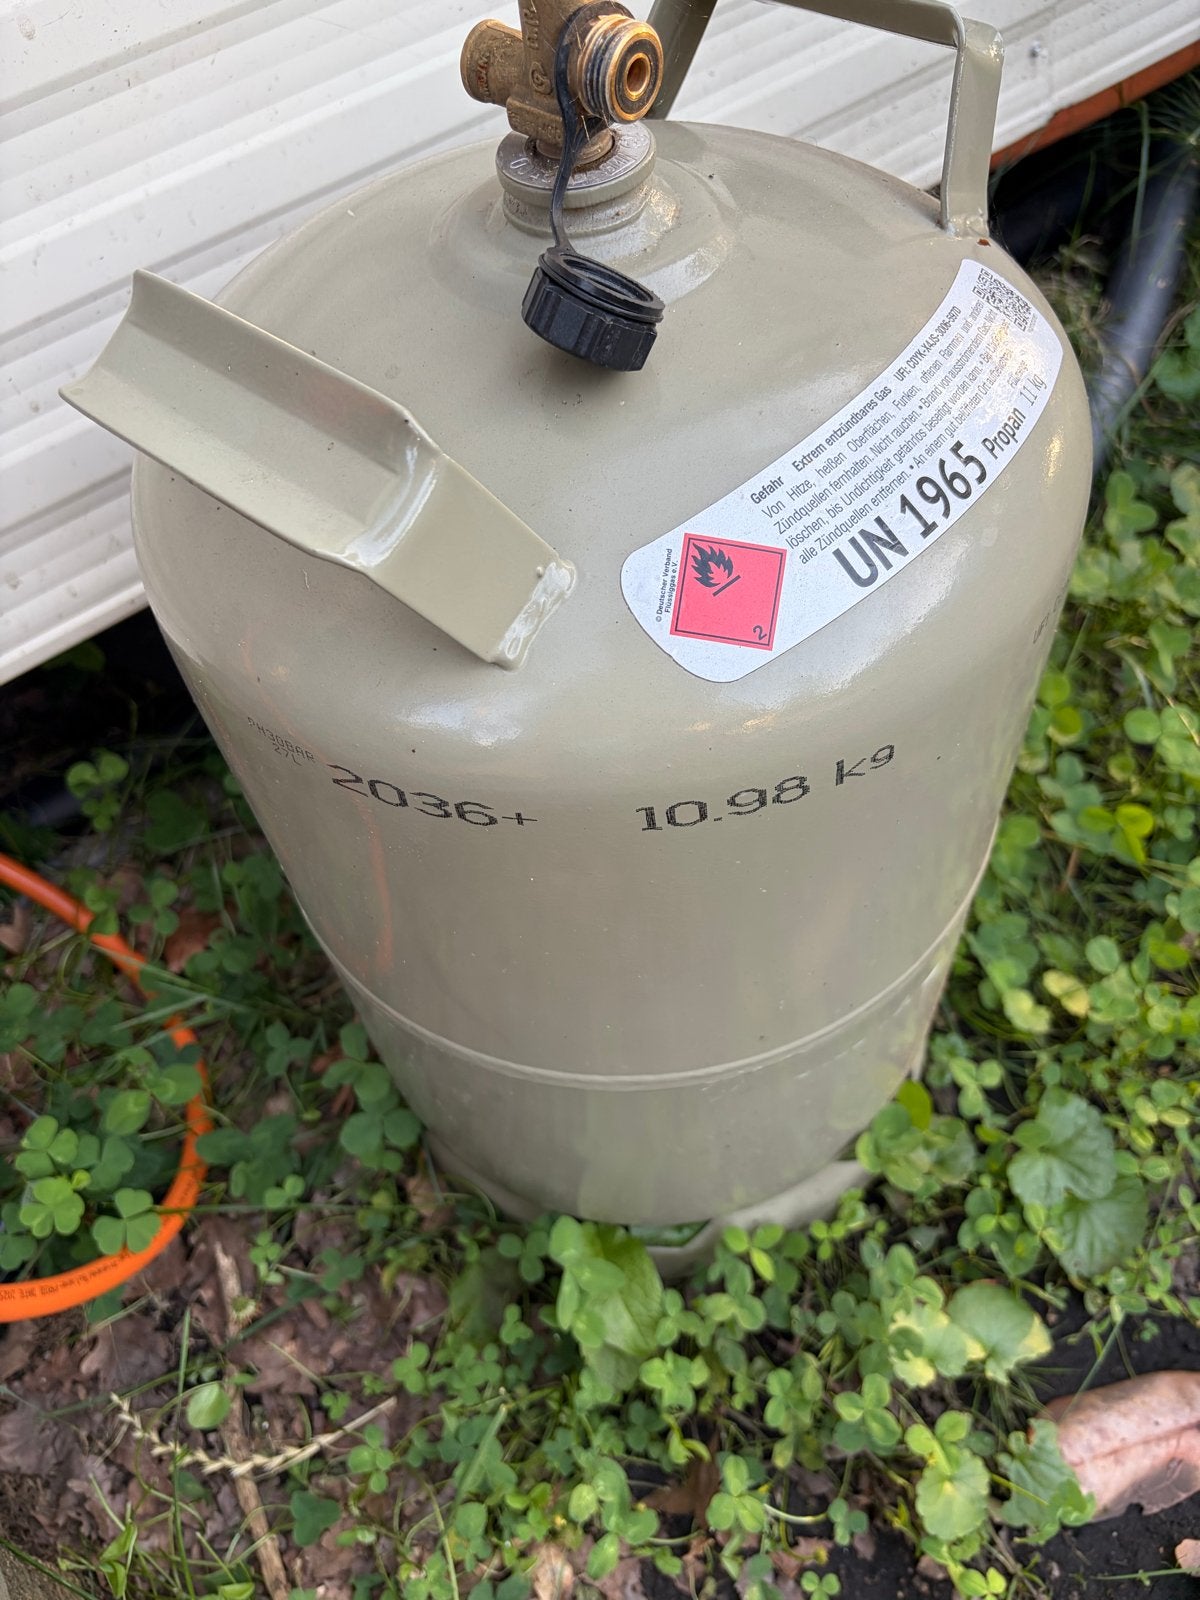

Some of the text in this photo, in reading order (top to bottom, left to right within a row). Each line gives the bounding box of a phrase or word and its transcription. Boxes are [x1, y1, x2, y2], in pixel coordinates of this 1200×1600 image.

[750, 476, 784, 504] Gefahr
[792, 443, 827, 472] Extrem
[825, 399, 878, 446] entzündbares
[874, 386, 892, 401] Gas
[893, 366, 911, 381] UFI:
[761, 500, 786, 519] Von
[786, 479, 816, 501] Hitze,
[815, 452, 847, 478] heißen
[846, 412, 896, 452] Oberflächen,
[892, 385, 922, 410] Funken,
[920, 360, 943, 383] offenen
[773, 487, 833, 535] Zündquellen
[828, 454, 874, 492] fernhalten.
[869, 435, 894, 457] Nicht
[891, 410, 922, 439] rauchen.
[920, 385, 942, 408] Brand
[938, 375, 953, 389] von
[785, 517, 830, 550] löschen,
[825, 503, 844, 519] bis
[840, 458, 896, 506] Undichtigkeit
[893, 429, 927, 464] gefahrlos
[922, 401, 952, 432] beseitigt
[948, 380, 971, 405] werden
[965, 366, 983, 383] kann.
[799, 546, 818, 564] alle
[814, 503, 873, 551] Zündquellen
[870, 471, 911, 507] entfernen.
[912, 454, 928, 468] An
[924, 433, 947, 457] einem
[944, 421, 959, 438] gut
[953, 393, 983, 425] belüfteten
[978, 382, 992, 395] Ort
[832, 374, 1047, 588] UN 1965 Propan 11 kg
[656, 579, 668, 615] Deutscher
[662, 548, 673, 577] Verband
[664, 560, 679, 614] Flüssiggas e.V.
[753, 624, 767, 641] 2
[326, 764, 538, 826] 2036+
[635, 744, 895, 831] 10.98 kg
